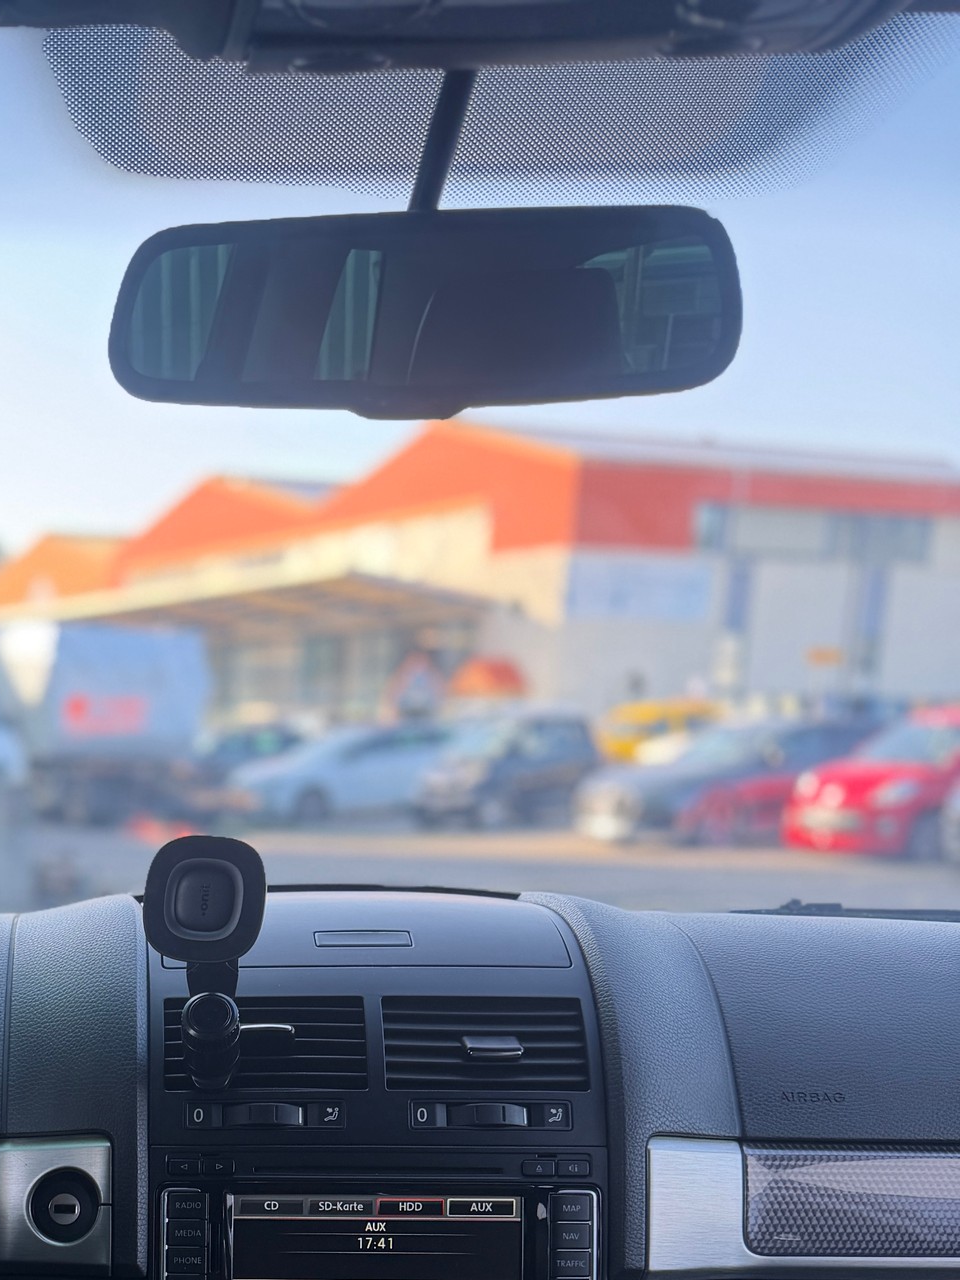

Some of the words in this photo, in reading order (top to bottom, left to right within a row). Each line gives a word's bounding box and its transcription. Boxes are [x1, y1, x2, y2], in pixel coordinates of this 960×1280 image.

[782, 1091, 845, 1103] AIRBAG
[192, 1108, 204, 1122] 0
[416, 1108, 428, 1122] 0
[175, 1200, 202, 1211] RADIO
[263, 1201, 279, 1212] CD
[318, 1201, 364, 1212] SD-Karte
[398, 1201, 423, 1212] HDD
[469, 1201, 493, 1212] AUX
[562, 1203, 581, 1213] MAP
[364, 1221, 387, 1232] AUX
[175, 1228, 202, 1238] MEDIA
[562, 1231, 580, 1241] NAV
[357, 1237, 395, 1250] 17:41
[173, 1255, 202, 1265] PHONE
[556, 1258, 586, 1268] TRAFFIC
